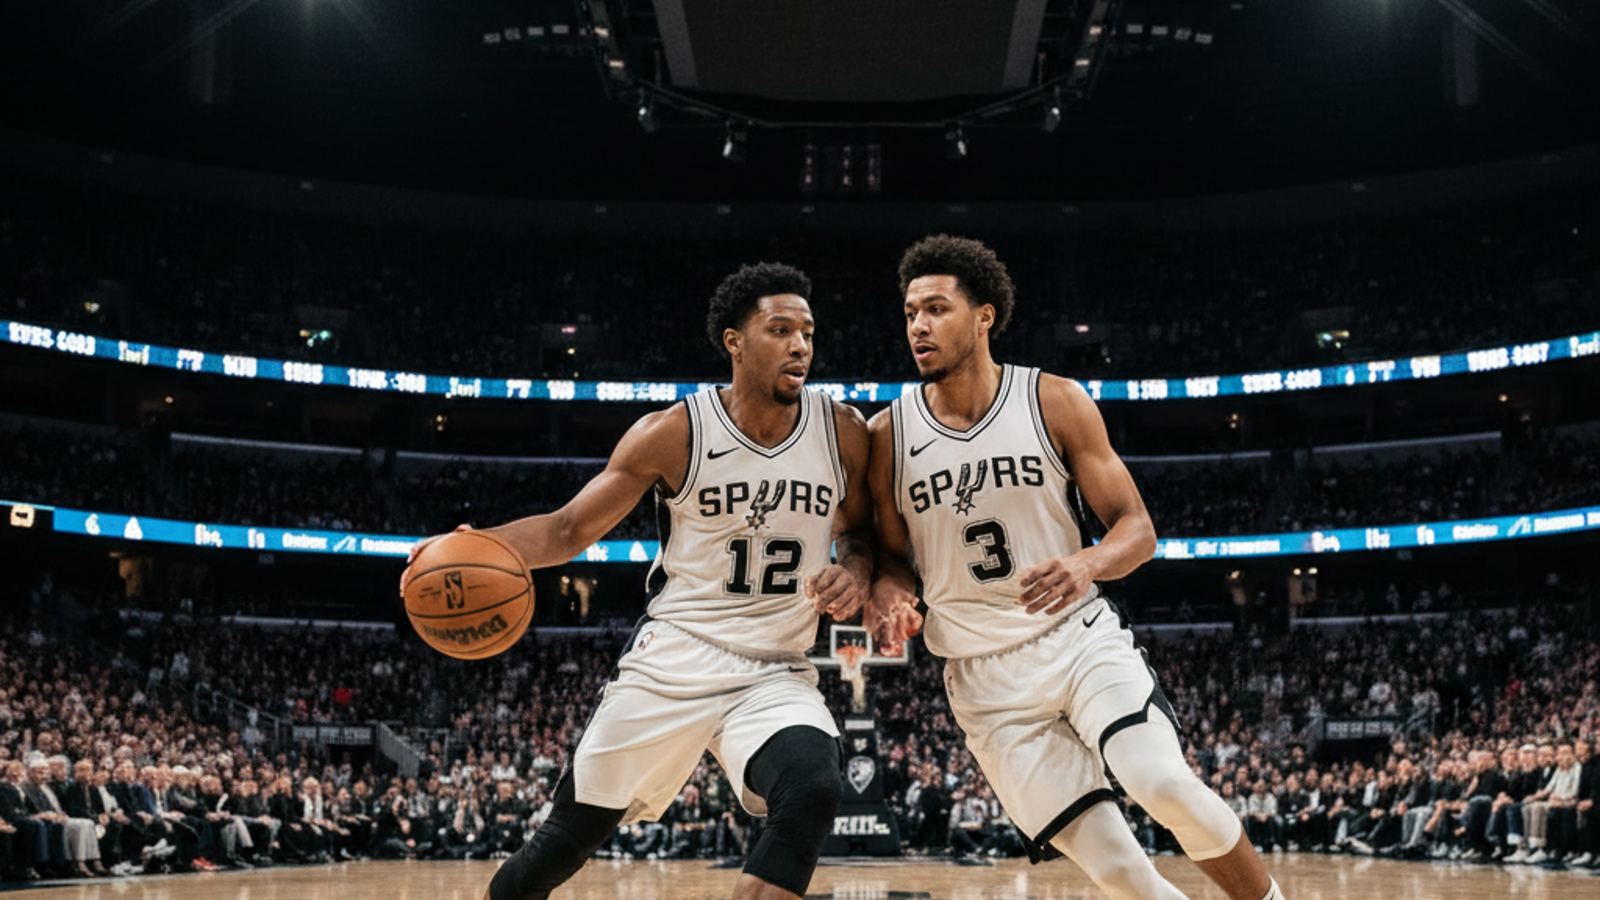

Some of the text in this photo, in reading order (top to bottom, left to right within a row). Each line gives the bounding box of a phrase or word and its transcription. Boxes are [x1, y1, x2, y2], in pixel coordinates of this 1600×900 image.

[699, 479, 832, 529] SPURS
[909, 455, 1045, 516] SPURS
[725, 538, 804, 596] 12
[963, 520, 1014, 582] 3
